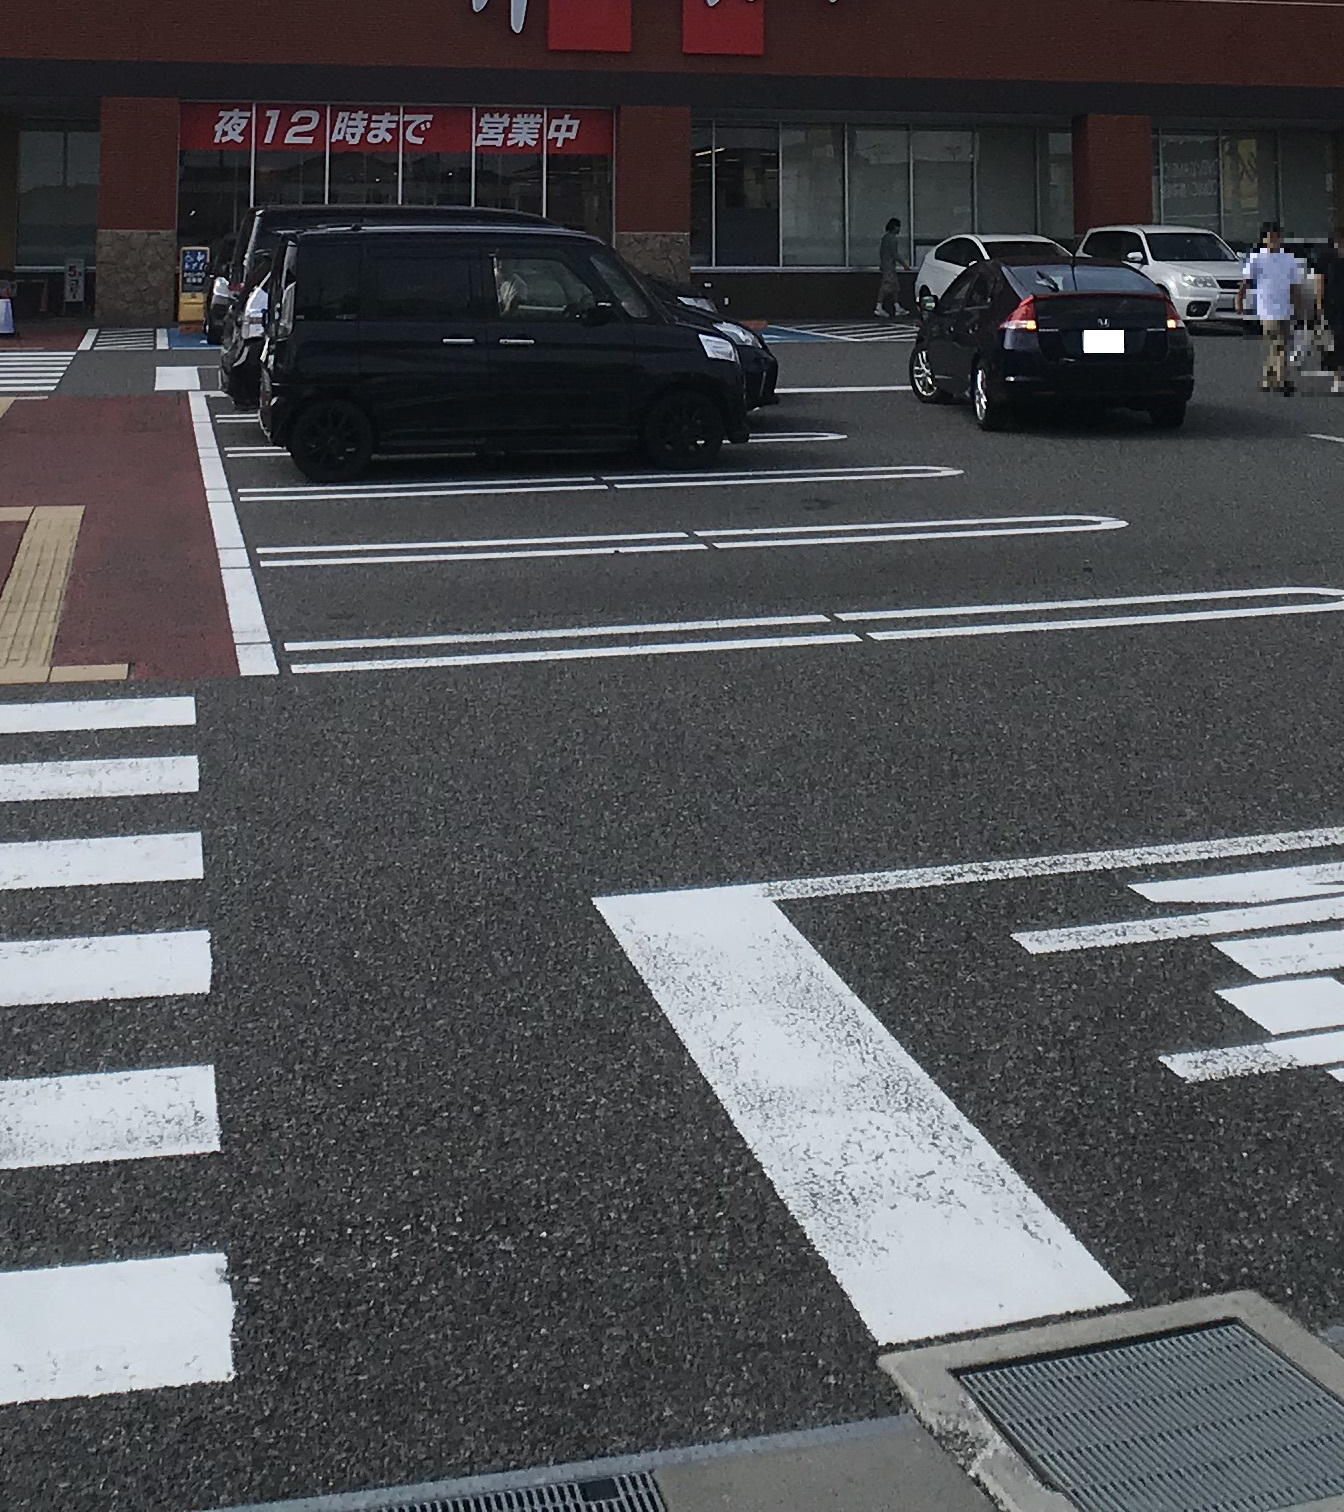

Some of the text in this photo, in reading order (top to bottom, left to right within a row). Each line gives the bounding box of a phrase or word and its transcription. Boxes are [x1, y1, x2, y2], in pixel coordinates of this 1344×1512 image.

[213, 109, 581, 148] 夜12時まで 営業中
